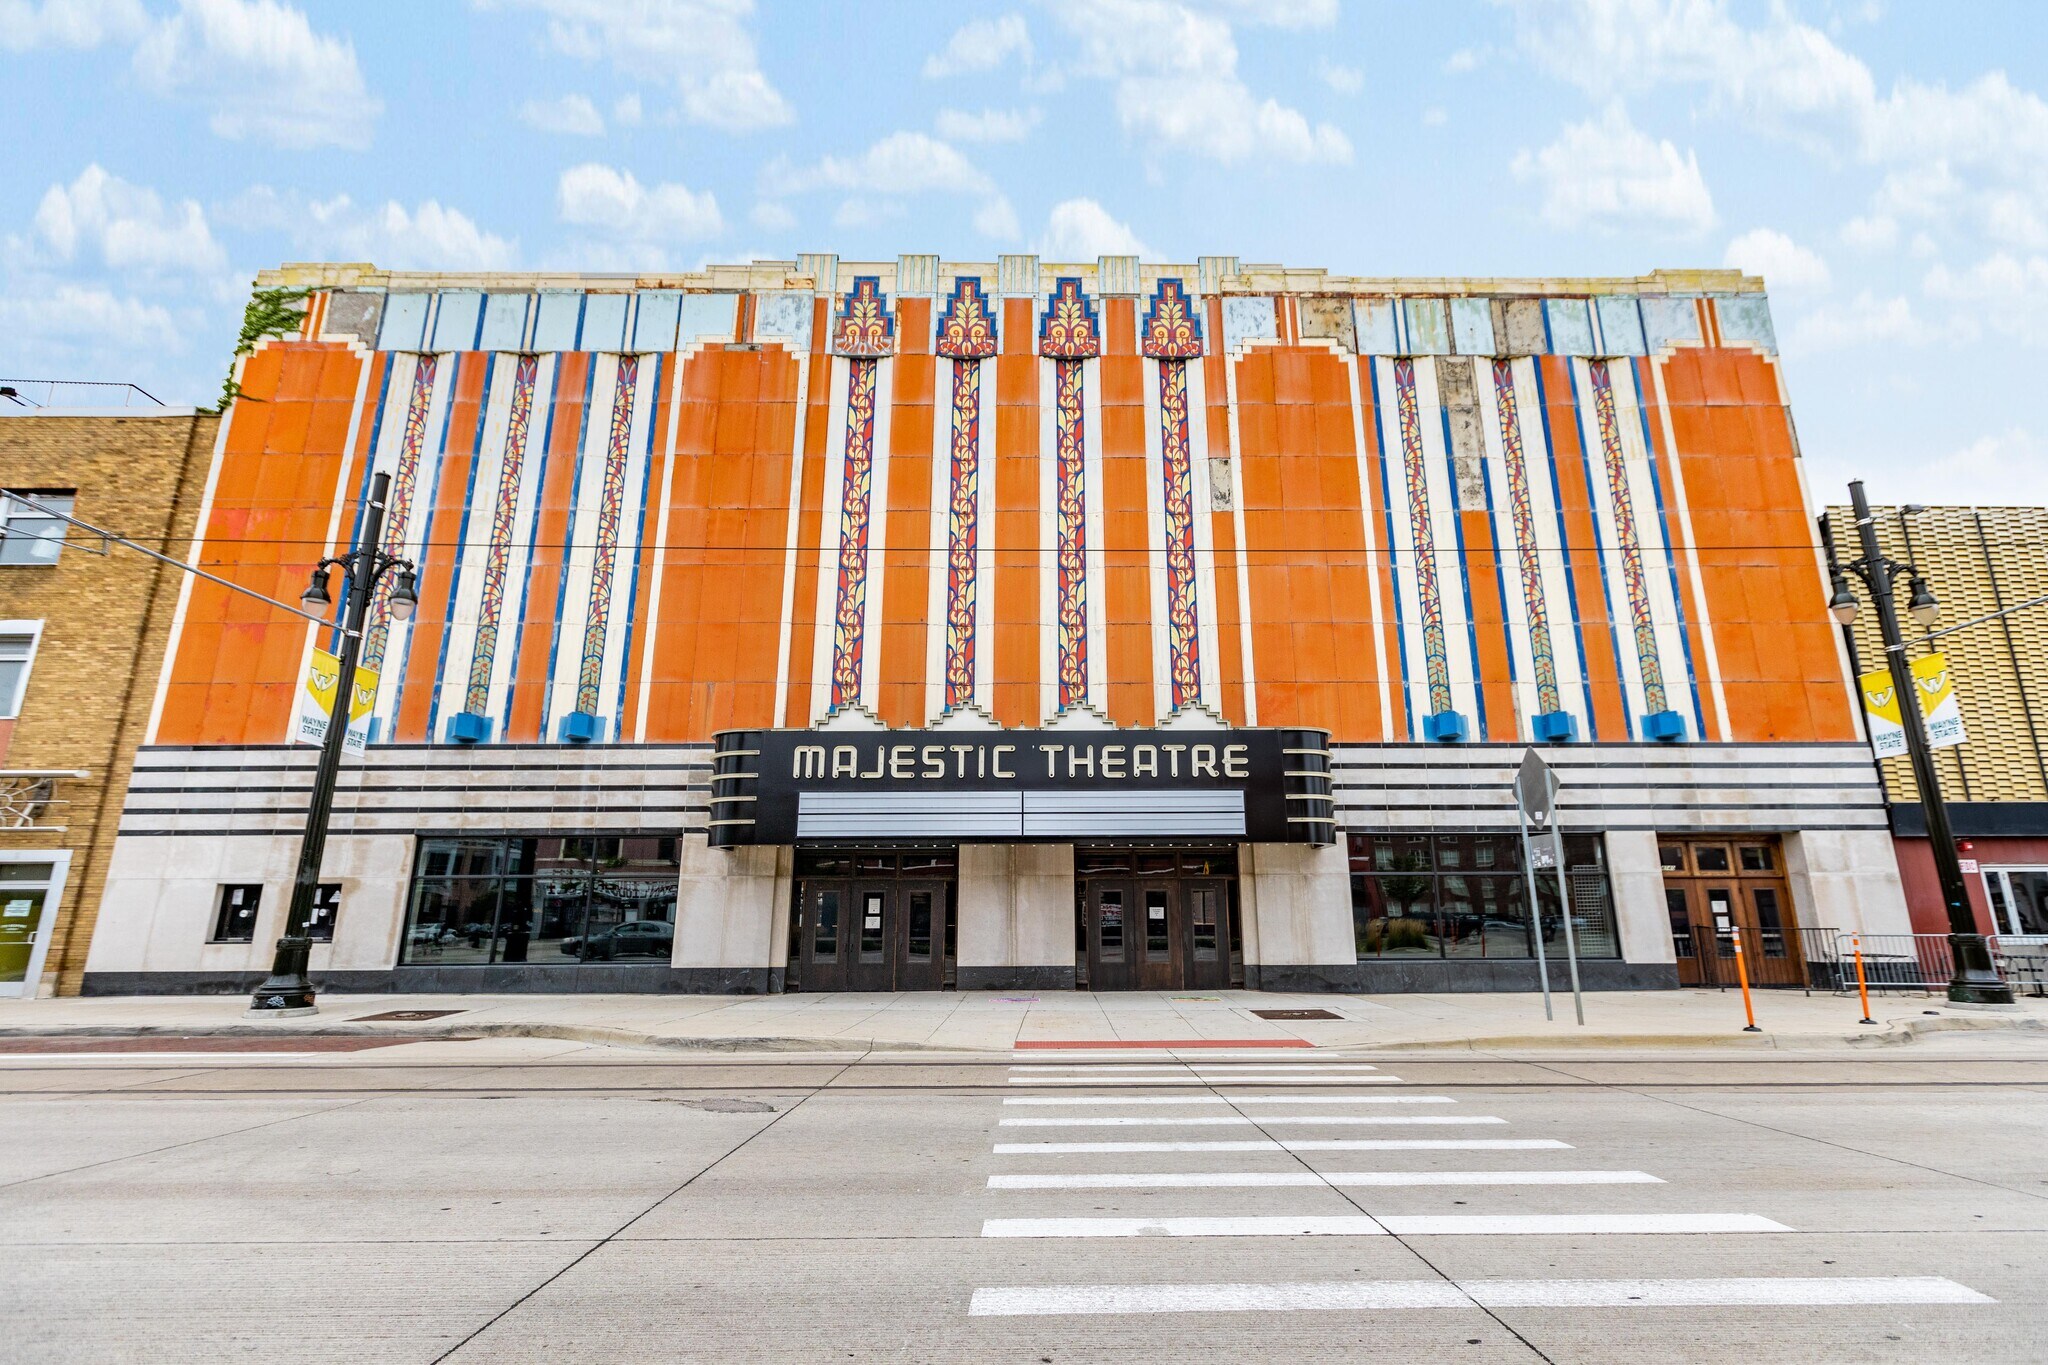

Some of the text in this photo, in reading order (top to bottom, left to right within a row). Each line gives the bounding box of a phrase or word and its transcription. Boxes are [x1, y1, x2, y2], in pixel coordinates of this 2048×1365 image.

[302, 715, 328, 730] WAYNE
[1930, 717, 1960, 730] WAYNE
[302, 725, 323, 738] STATE
[347, 728, 367, 741] WAYNE
[1875, 730, 1903, 742] WAYNE
[1934, 726, 1959, 739] STATE
[347, 738, 362, 749] STATE
[1879, 739, 1902, 750] STATE
[793, 744, 1250, 779] MAJESTIC THEATRE
